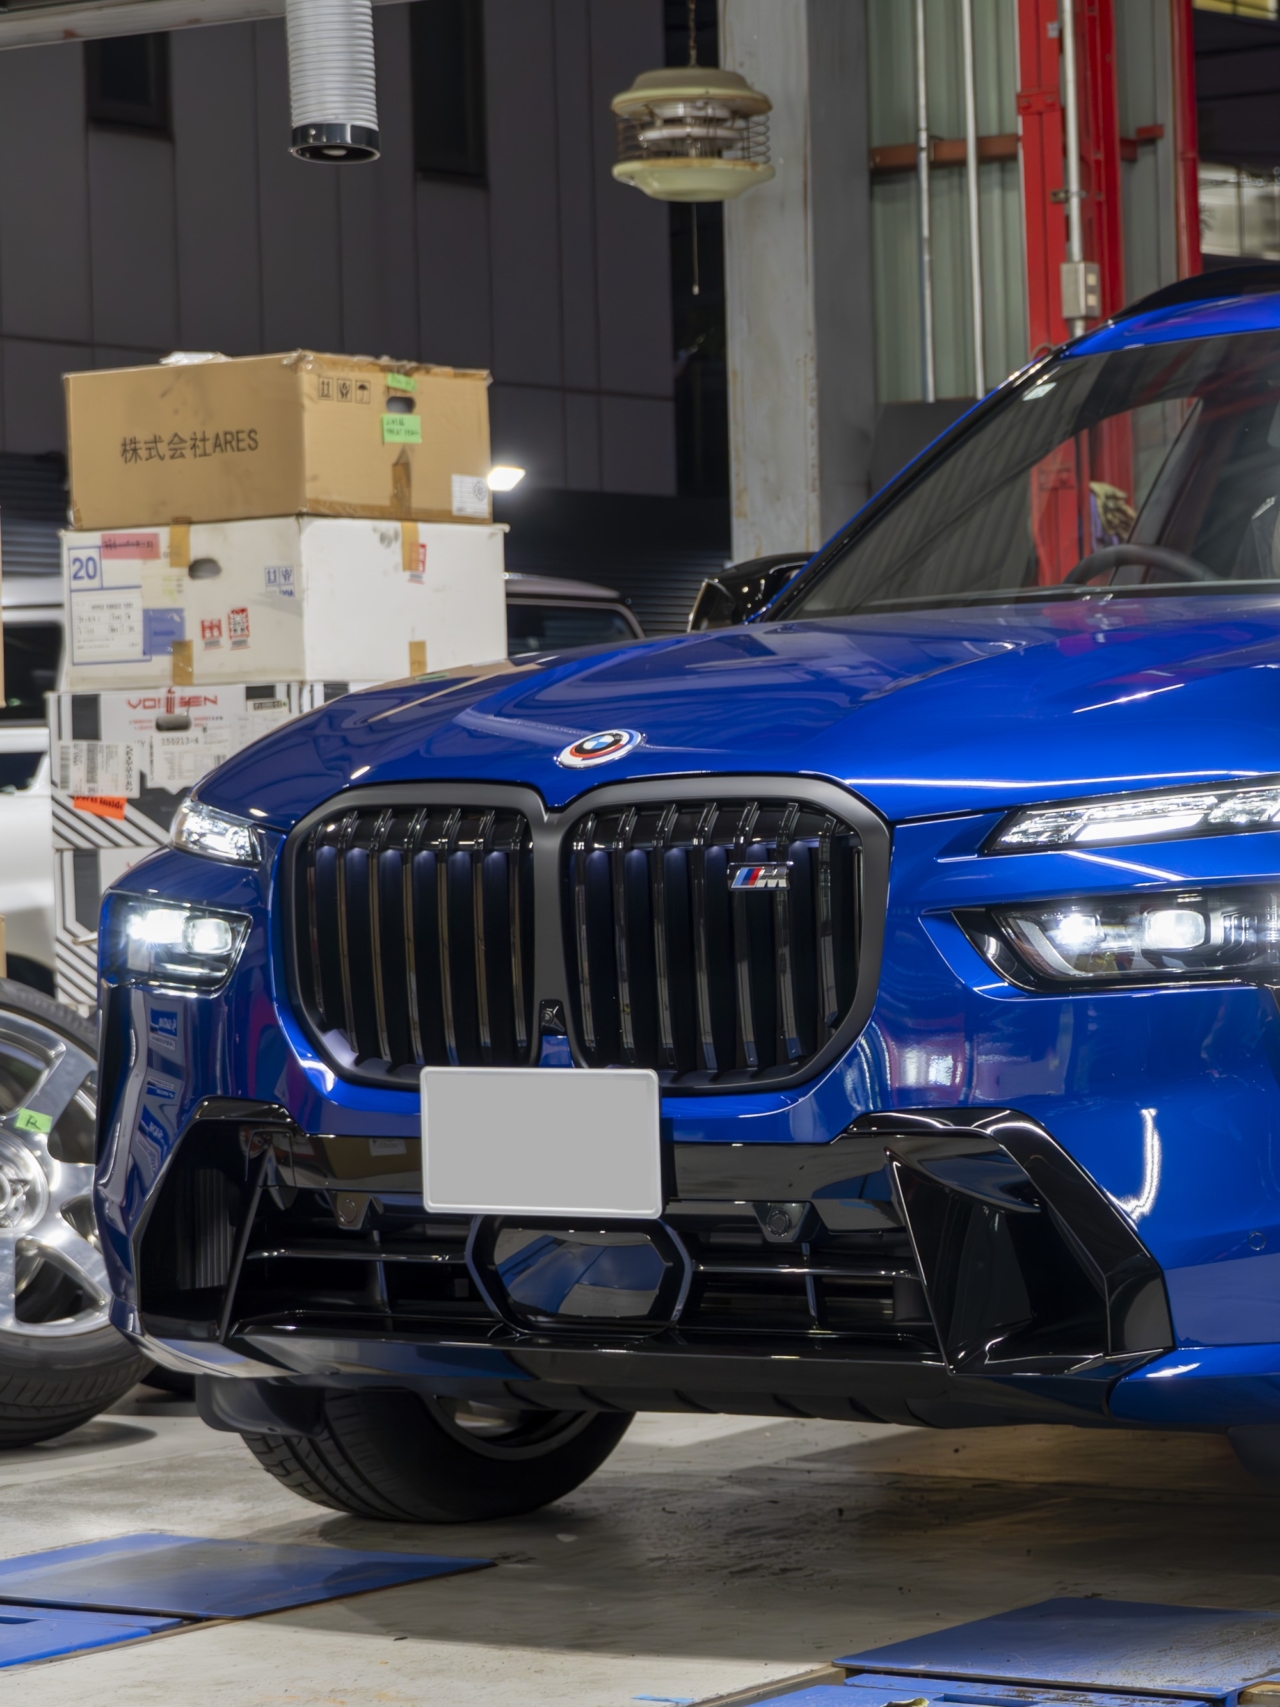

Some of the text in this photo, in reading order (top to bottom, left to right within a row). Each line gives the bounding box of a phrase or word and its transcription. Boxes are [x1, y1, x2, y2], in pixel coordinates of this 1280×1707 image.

[120, 428, 259, 464] 株式会社ARES
[72, 556, 98, 580] 20
[127, 695, 218, 710] VOSEN
